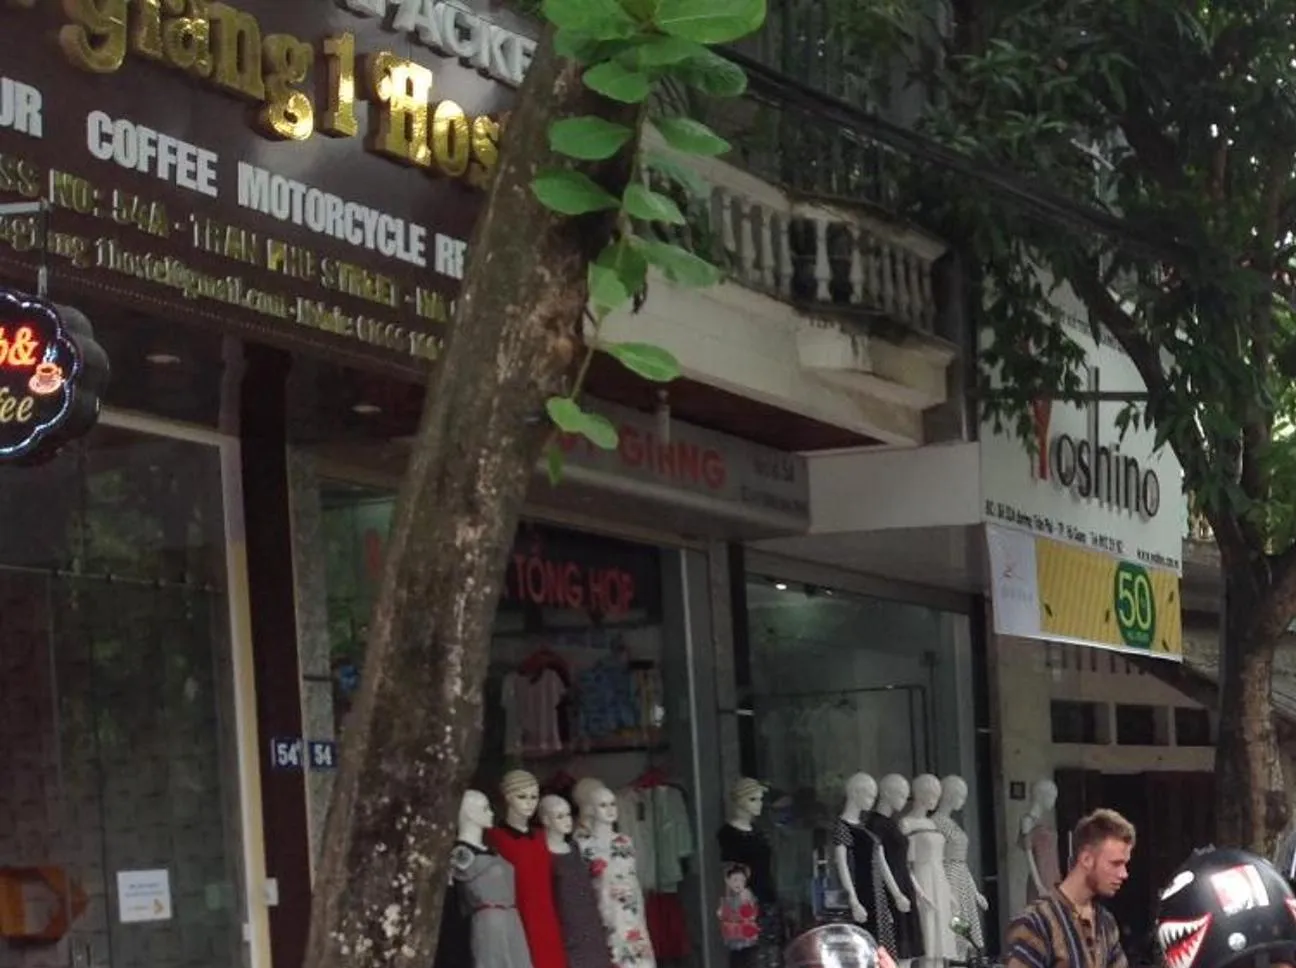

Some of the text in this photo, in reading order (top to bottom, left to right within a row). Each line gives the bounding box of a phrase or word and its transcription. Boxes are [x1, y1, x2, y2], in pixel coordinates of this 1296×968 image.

[86, 109, 218, 198] COFFEE
[237, 160, 427, 268] MOTORCYCLE
[1118, 570, 1151, 631] 50
